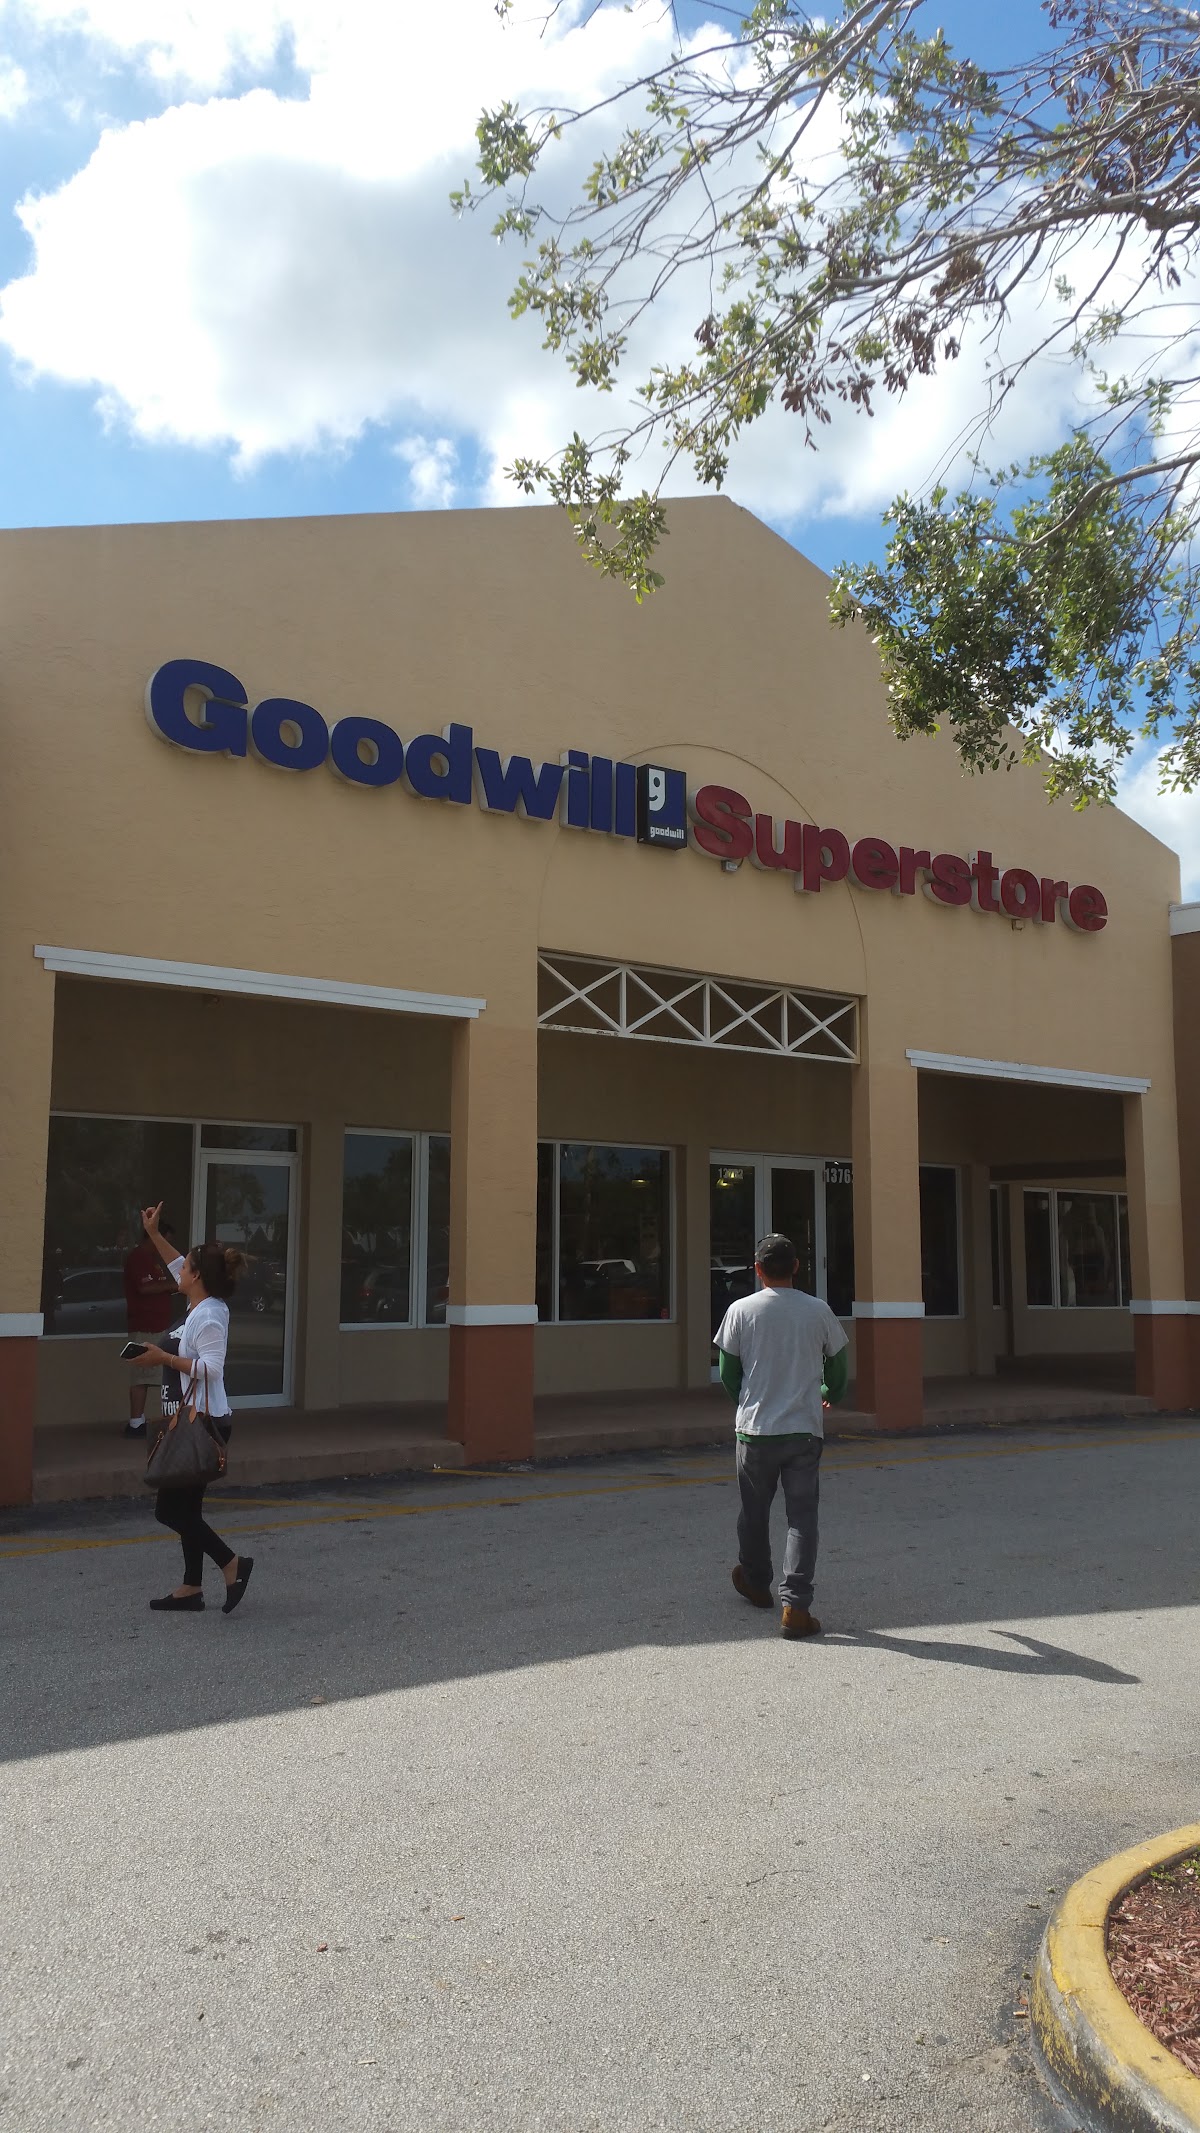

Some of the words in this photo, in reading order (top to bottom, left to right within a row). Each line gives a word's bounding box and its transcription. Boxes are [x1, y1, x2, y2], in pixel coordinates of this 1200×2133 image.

[146, 658, 637, 838] Goodwill
[688, 784, 1109, 933] Superstore
[650, 826, 685, 840] goodwill
[825, 1167, 853, 1184] 1376
